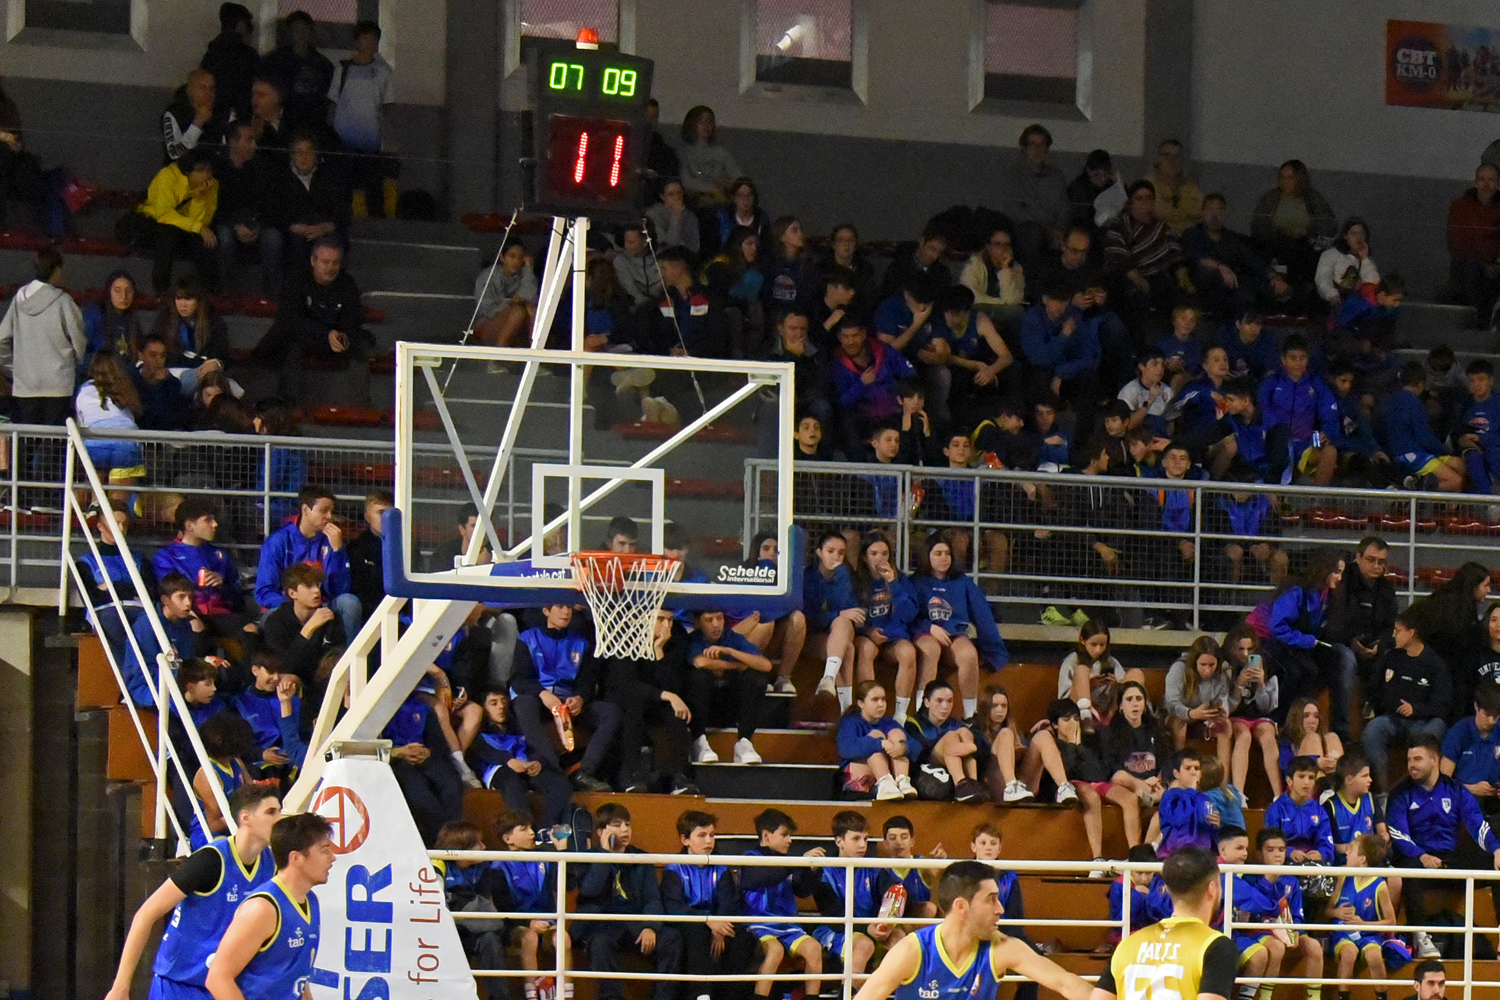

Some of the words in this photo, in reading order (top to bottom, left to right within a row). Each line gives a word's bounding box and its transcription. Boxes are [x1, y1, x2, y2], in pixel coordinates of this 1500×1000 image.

[1396, 48, 1437, 65] CBT
[549, 62, 585, 91] 07
[602, 67, 637, 97] 09
[1396, 63, 1437, 79] KM-0
[573, 131, 624, 188] 11
[717, 564, 777, 582] Schelde
[409, 867, 441, 923] Life
[287, 934, 305, 949] tac
[407, 938, 439, 985] for
[918, 987, 940, 999] tac
